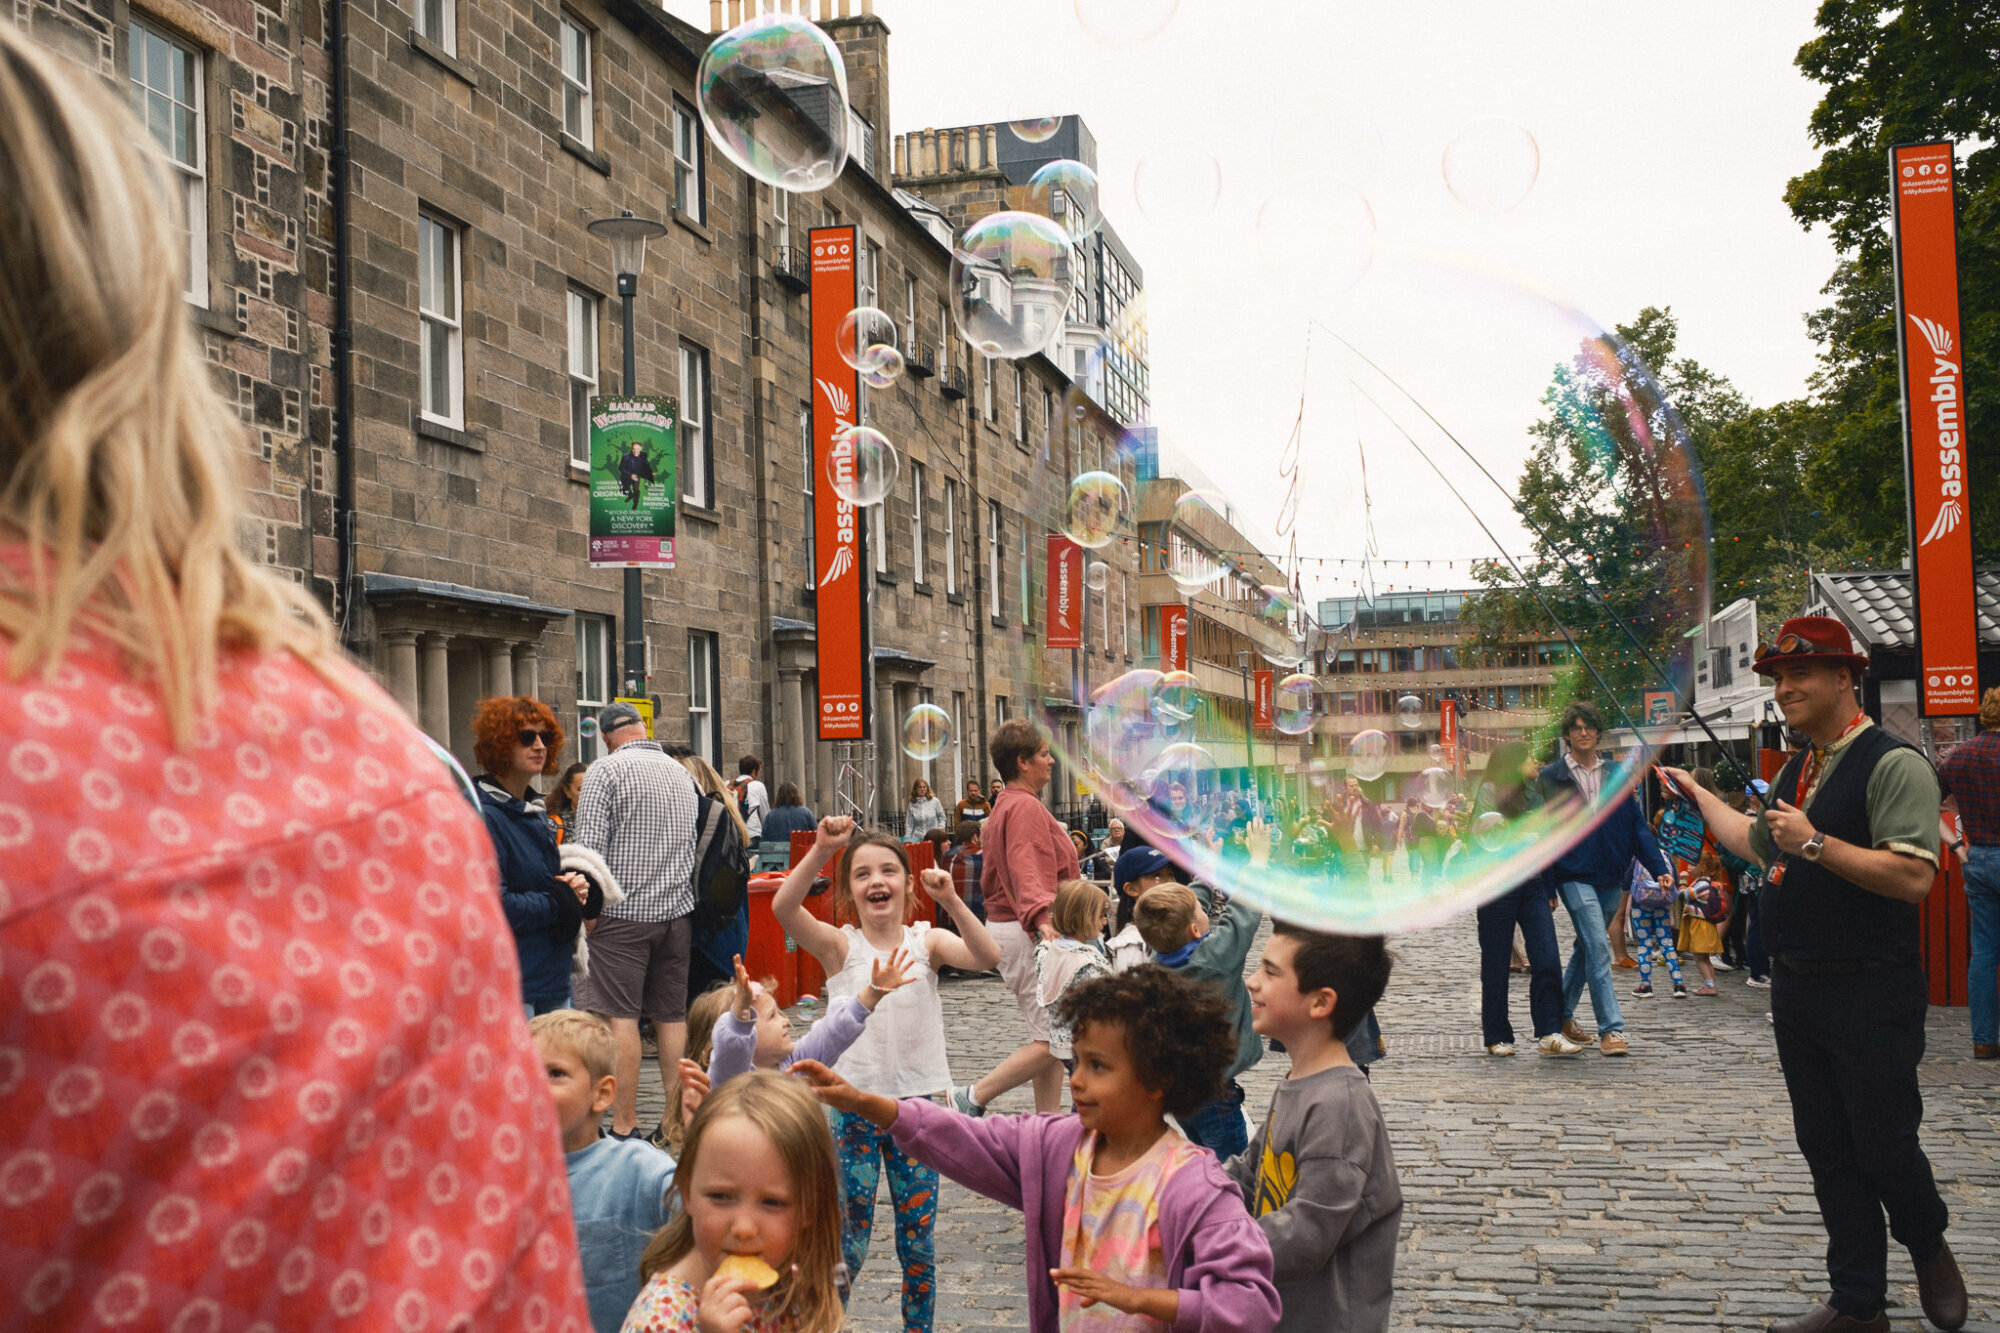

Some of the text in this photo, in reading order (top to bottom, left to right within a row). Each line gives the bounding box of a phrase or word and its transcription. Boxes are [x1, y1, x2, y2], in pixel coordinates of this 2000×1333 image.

[1902, 178, 1948, 188] @AssemblyFest
[1903, 186, 1948, 195] #MyAssembly
[1930, 358, 1962, 498] assembly
[1058, 561, 1069, 616] assembly
[1928, 689, 1974, 697] @AssemblyFest
[1929, 697, 1974, 705] #MyAssembly
